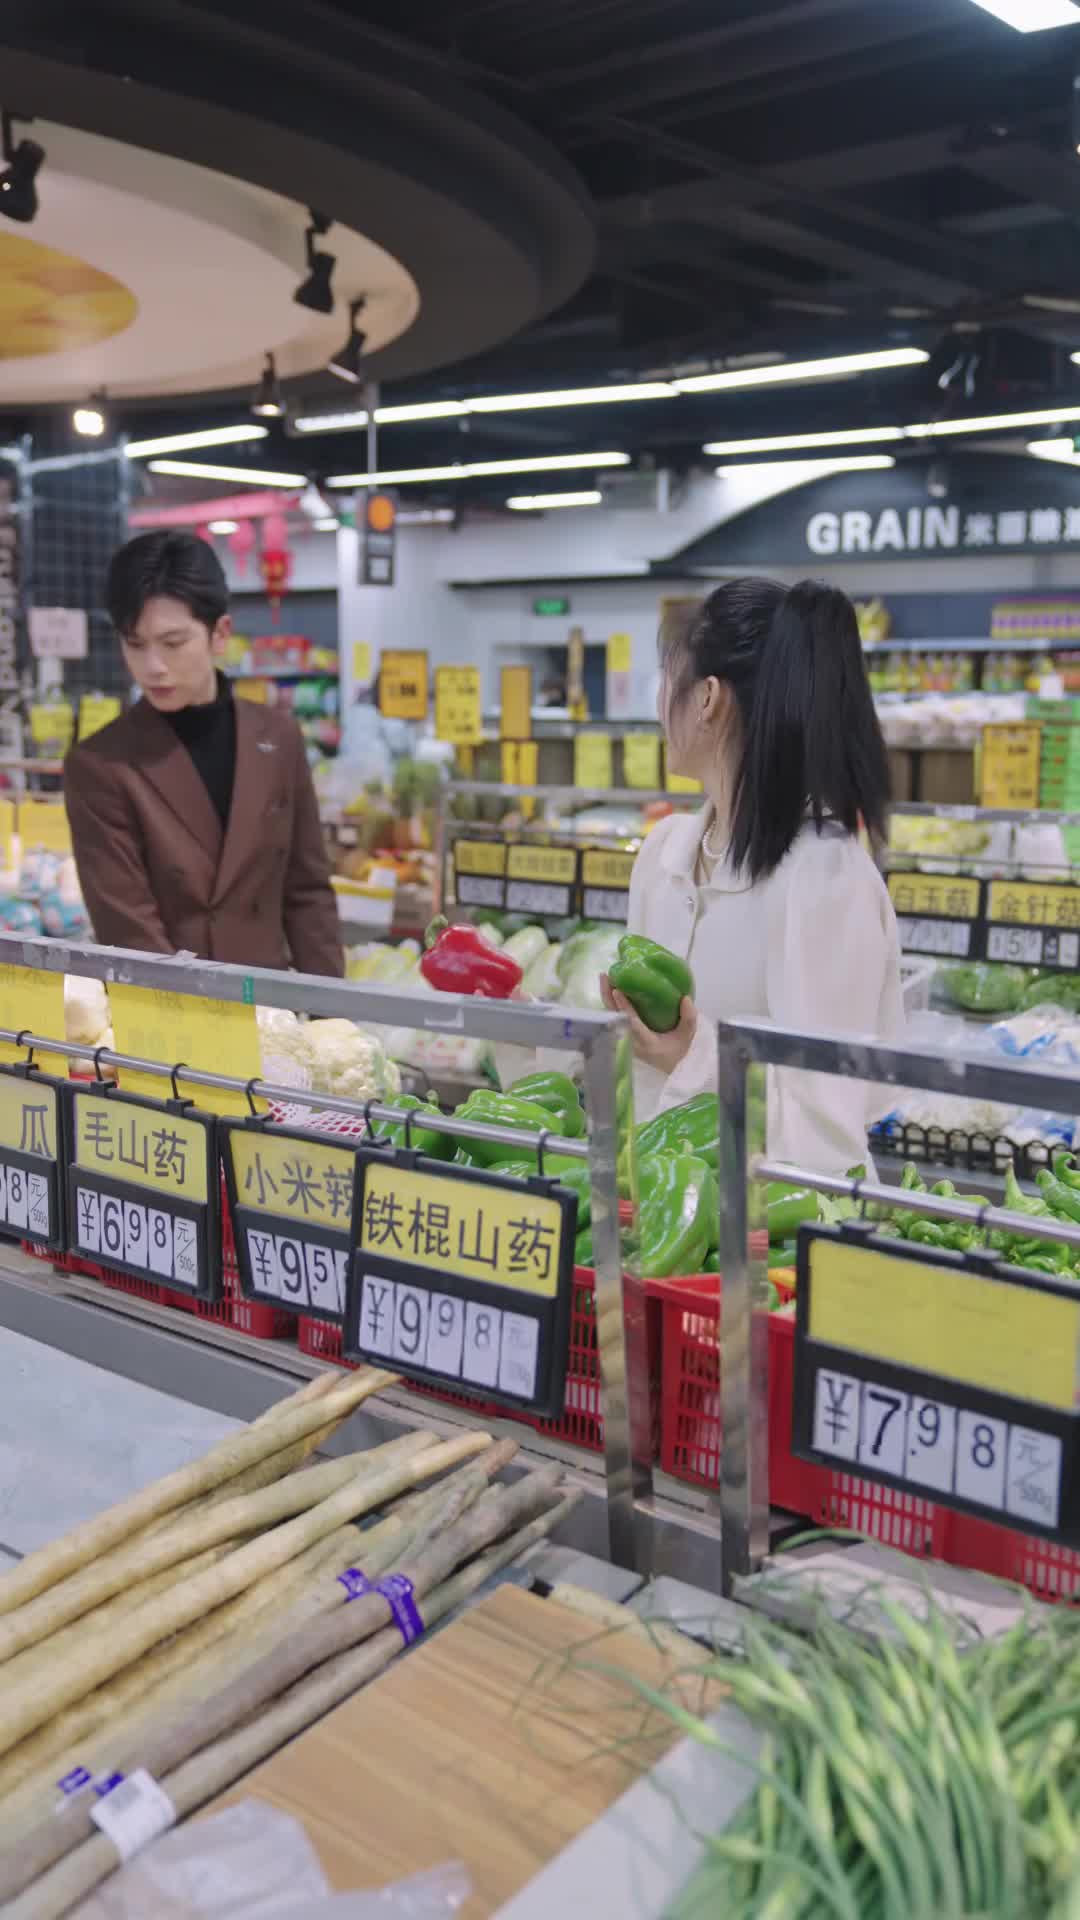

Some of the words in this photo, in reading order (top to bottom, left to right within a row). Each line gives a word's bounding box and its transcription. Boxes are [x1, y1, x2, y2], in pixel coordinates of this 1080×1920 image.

[806, 505, 959, 555] GRAIN
[19, 1104, 52, 1158] 瓜
[83, 1111, 188, 1185] 毛山药
[364, 1191, 555, 1280] 铁棍山药
